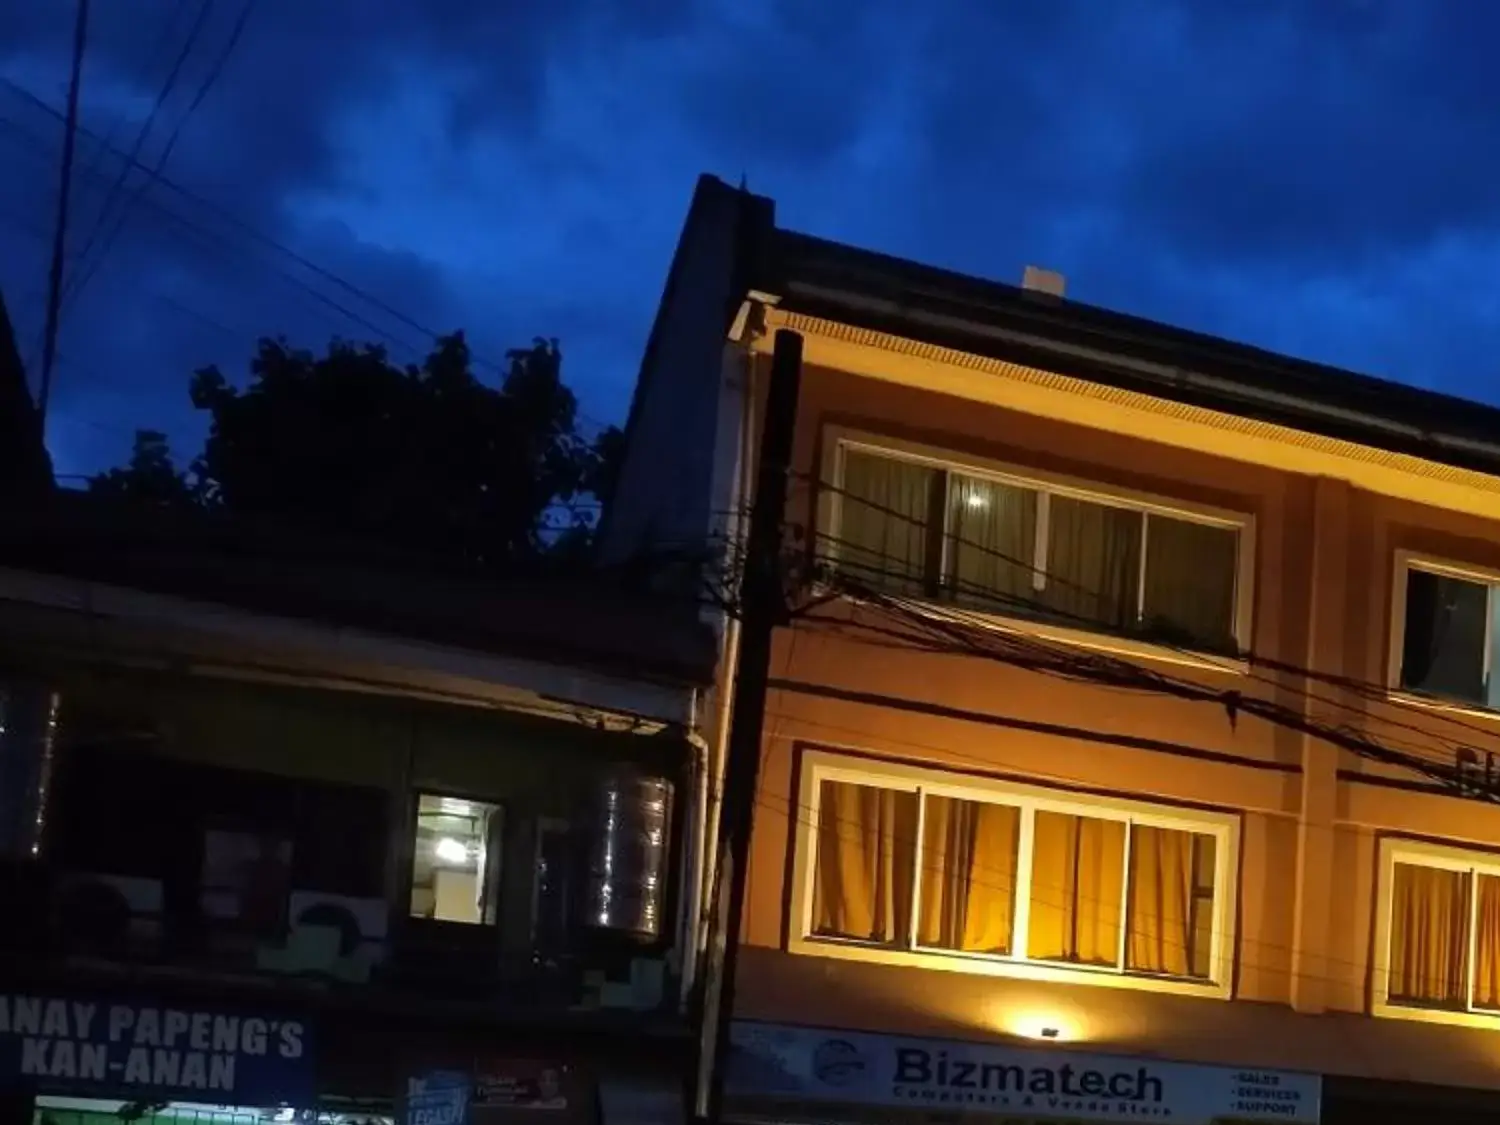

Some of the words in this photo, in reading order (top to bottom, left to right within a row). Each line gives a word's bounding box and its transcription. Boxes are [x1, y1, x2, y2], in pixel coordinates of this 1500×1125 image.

[109, 1005, 304, 1058] PAPENG'S
[21, 1037, 236, 1091] KAN-ANAN
[893, 1047, 1163, 1103] Bizmatech
